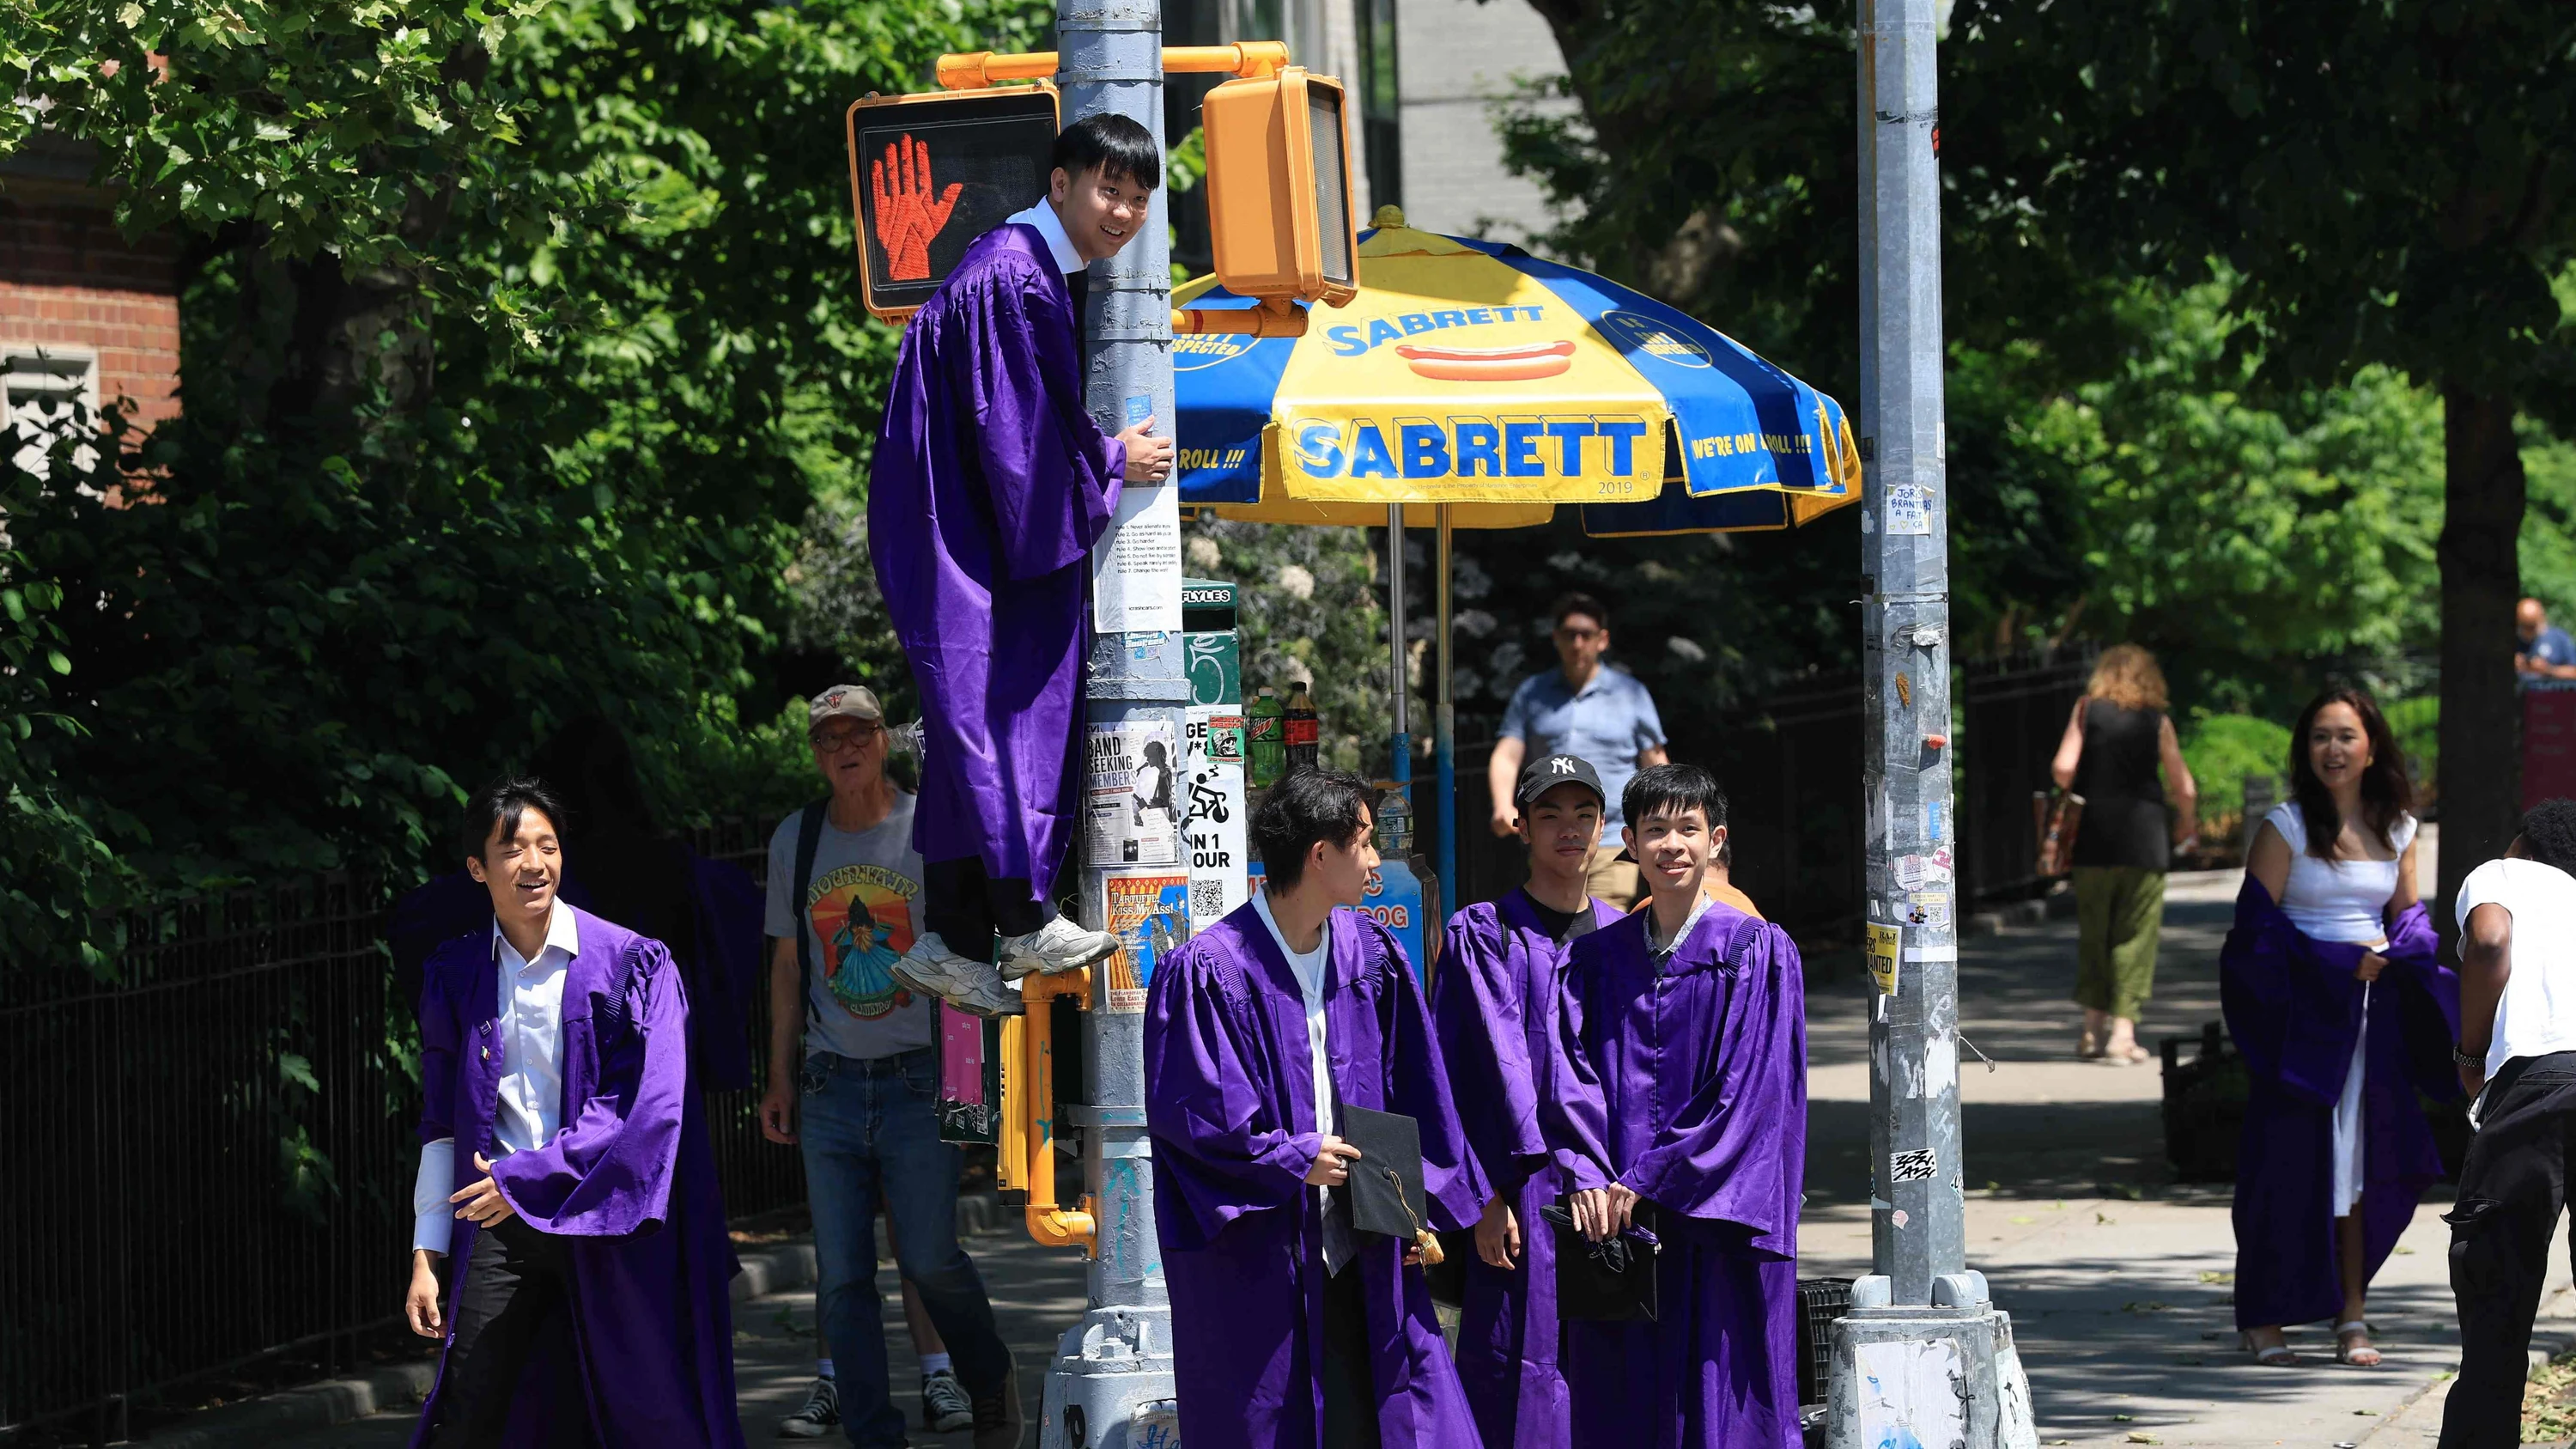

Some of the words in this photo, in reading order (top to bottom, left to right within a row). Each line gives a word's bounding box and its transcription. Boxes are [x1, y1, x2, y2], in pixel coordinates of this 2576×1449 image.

[1317, 302, 1544, 356] SABRETT
[1172, 338, 1241, 356] SPECTED
[1291, 415, 1647, 478] SABRETT
[1691, 435, 1733, 460] WE'RE
[1735, 432, 1756, 454] ON
[1178, 447, 1219, 470] ROLL
[1223, 449, 1246, 469] !!!
[1598, 481, 1633, 495] 2019
[1182, 590, 1230, 602] FLYLES
[1087, 736, 1121, 758] BAND
[1088, 755, 1133, 774] SEEKING
[1551, 757, 1577, 775] NY
[1089, 770, 1138, 788] MEMBERS
[1212, 833, 1219, 849] 1
[1193, 852, 1230, 868] OUR
[1111, 892, 1160, 904] TARTUFFE,
[1111, 904, 1133, 916] KISS
[1135, 903, 1151, 916] MY
[1151, 902, 1174, 915] ASS!
